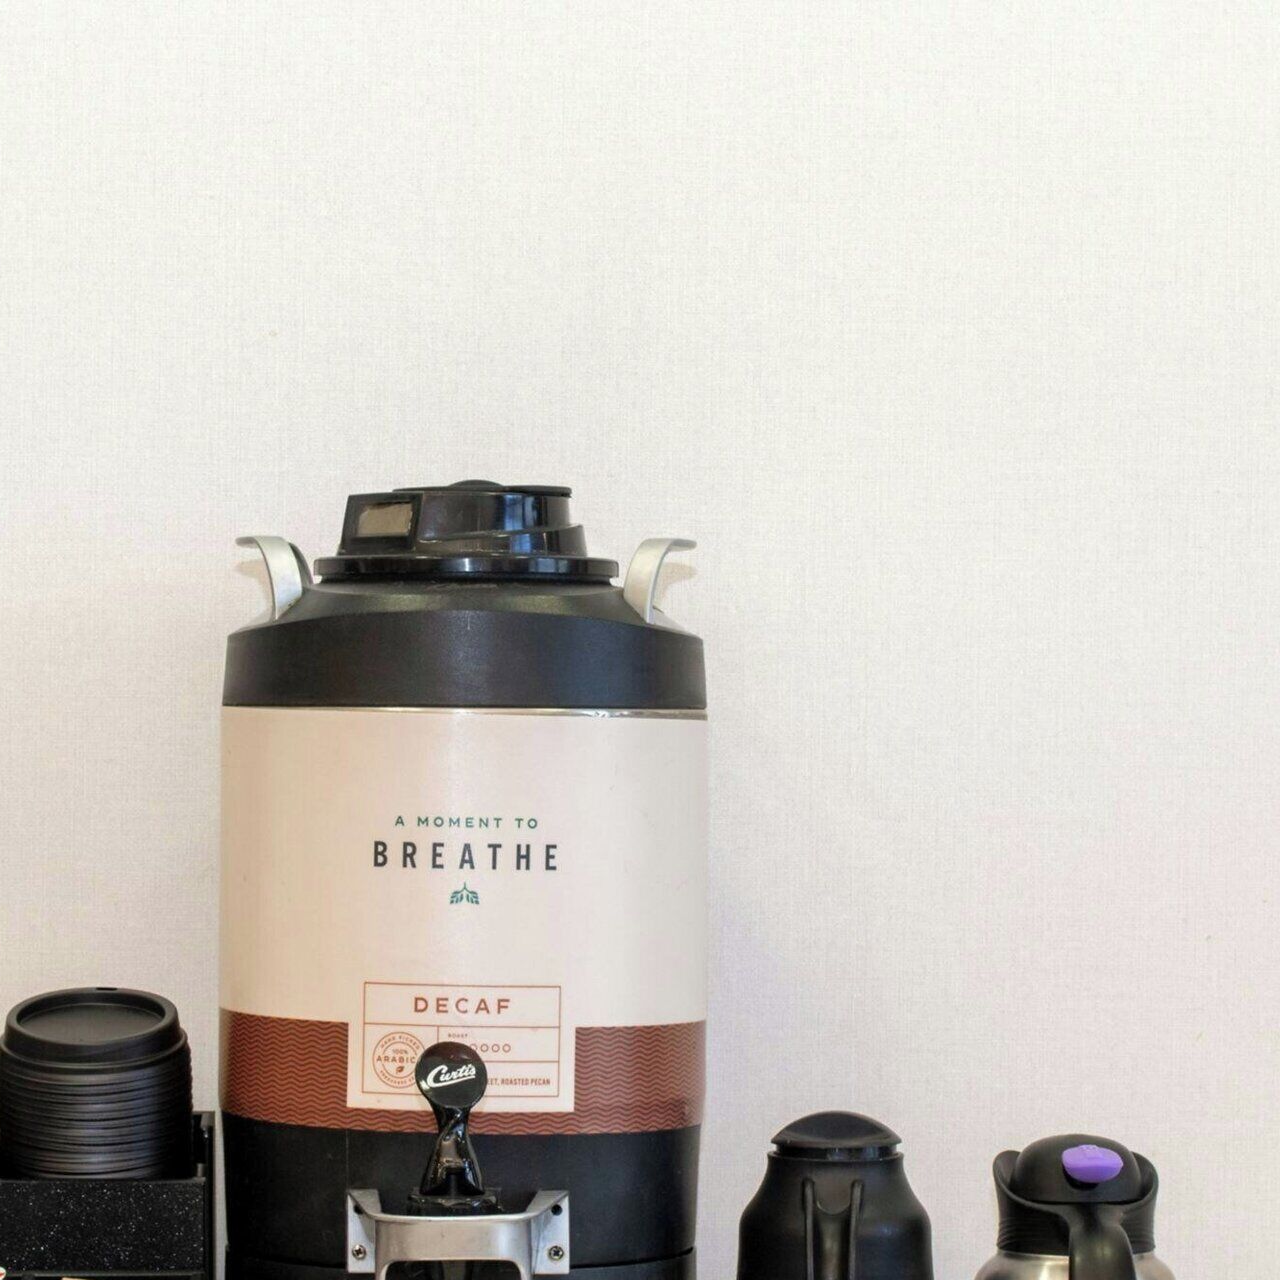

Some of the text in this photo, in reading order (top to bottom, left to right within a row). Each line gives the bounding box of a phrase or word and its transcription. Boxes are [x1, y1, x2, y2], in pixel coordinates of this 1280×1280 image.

[394, 815, 539, 830] A MOMENT TO
[373, 841, 558, 871] BREATHE
[414, 997, 511, 1015] DECAF
[377, 1055, 416, 1064] ARABIC
[427, 1063, 476, 1088] Curtis
[501, 1078, 529, 1086] ROASTED
[531, 1078, 550, 1086] PECAN
